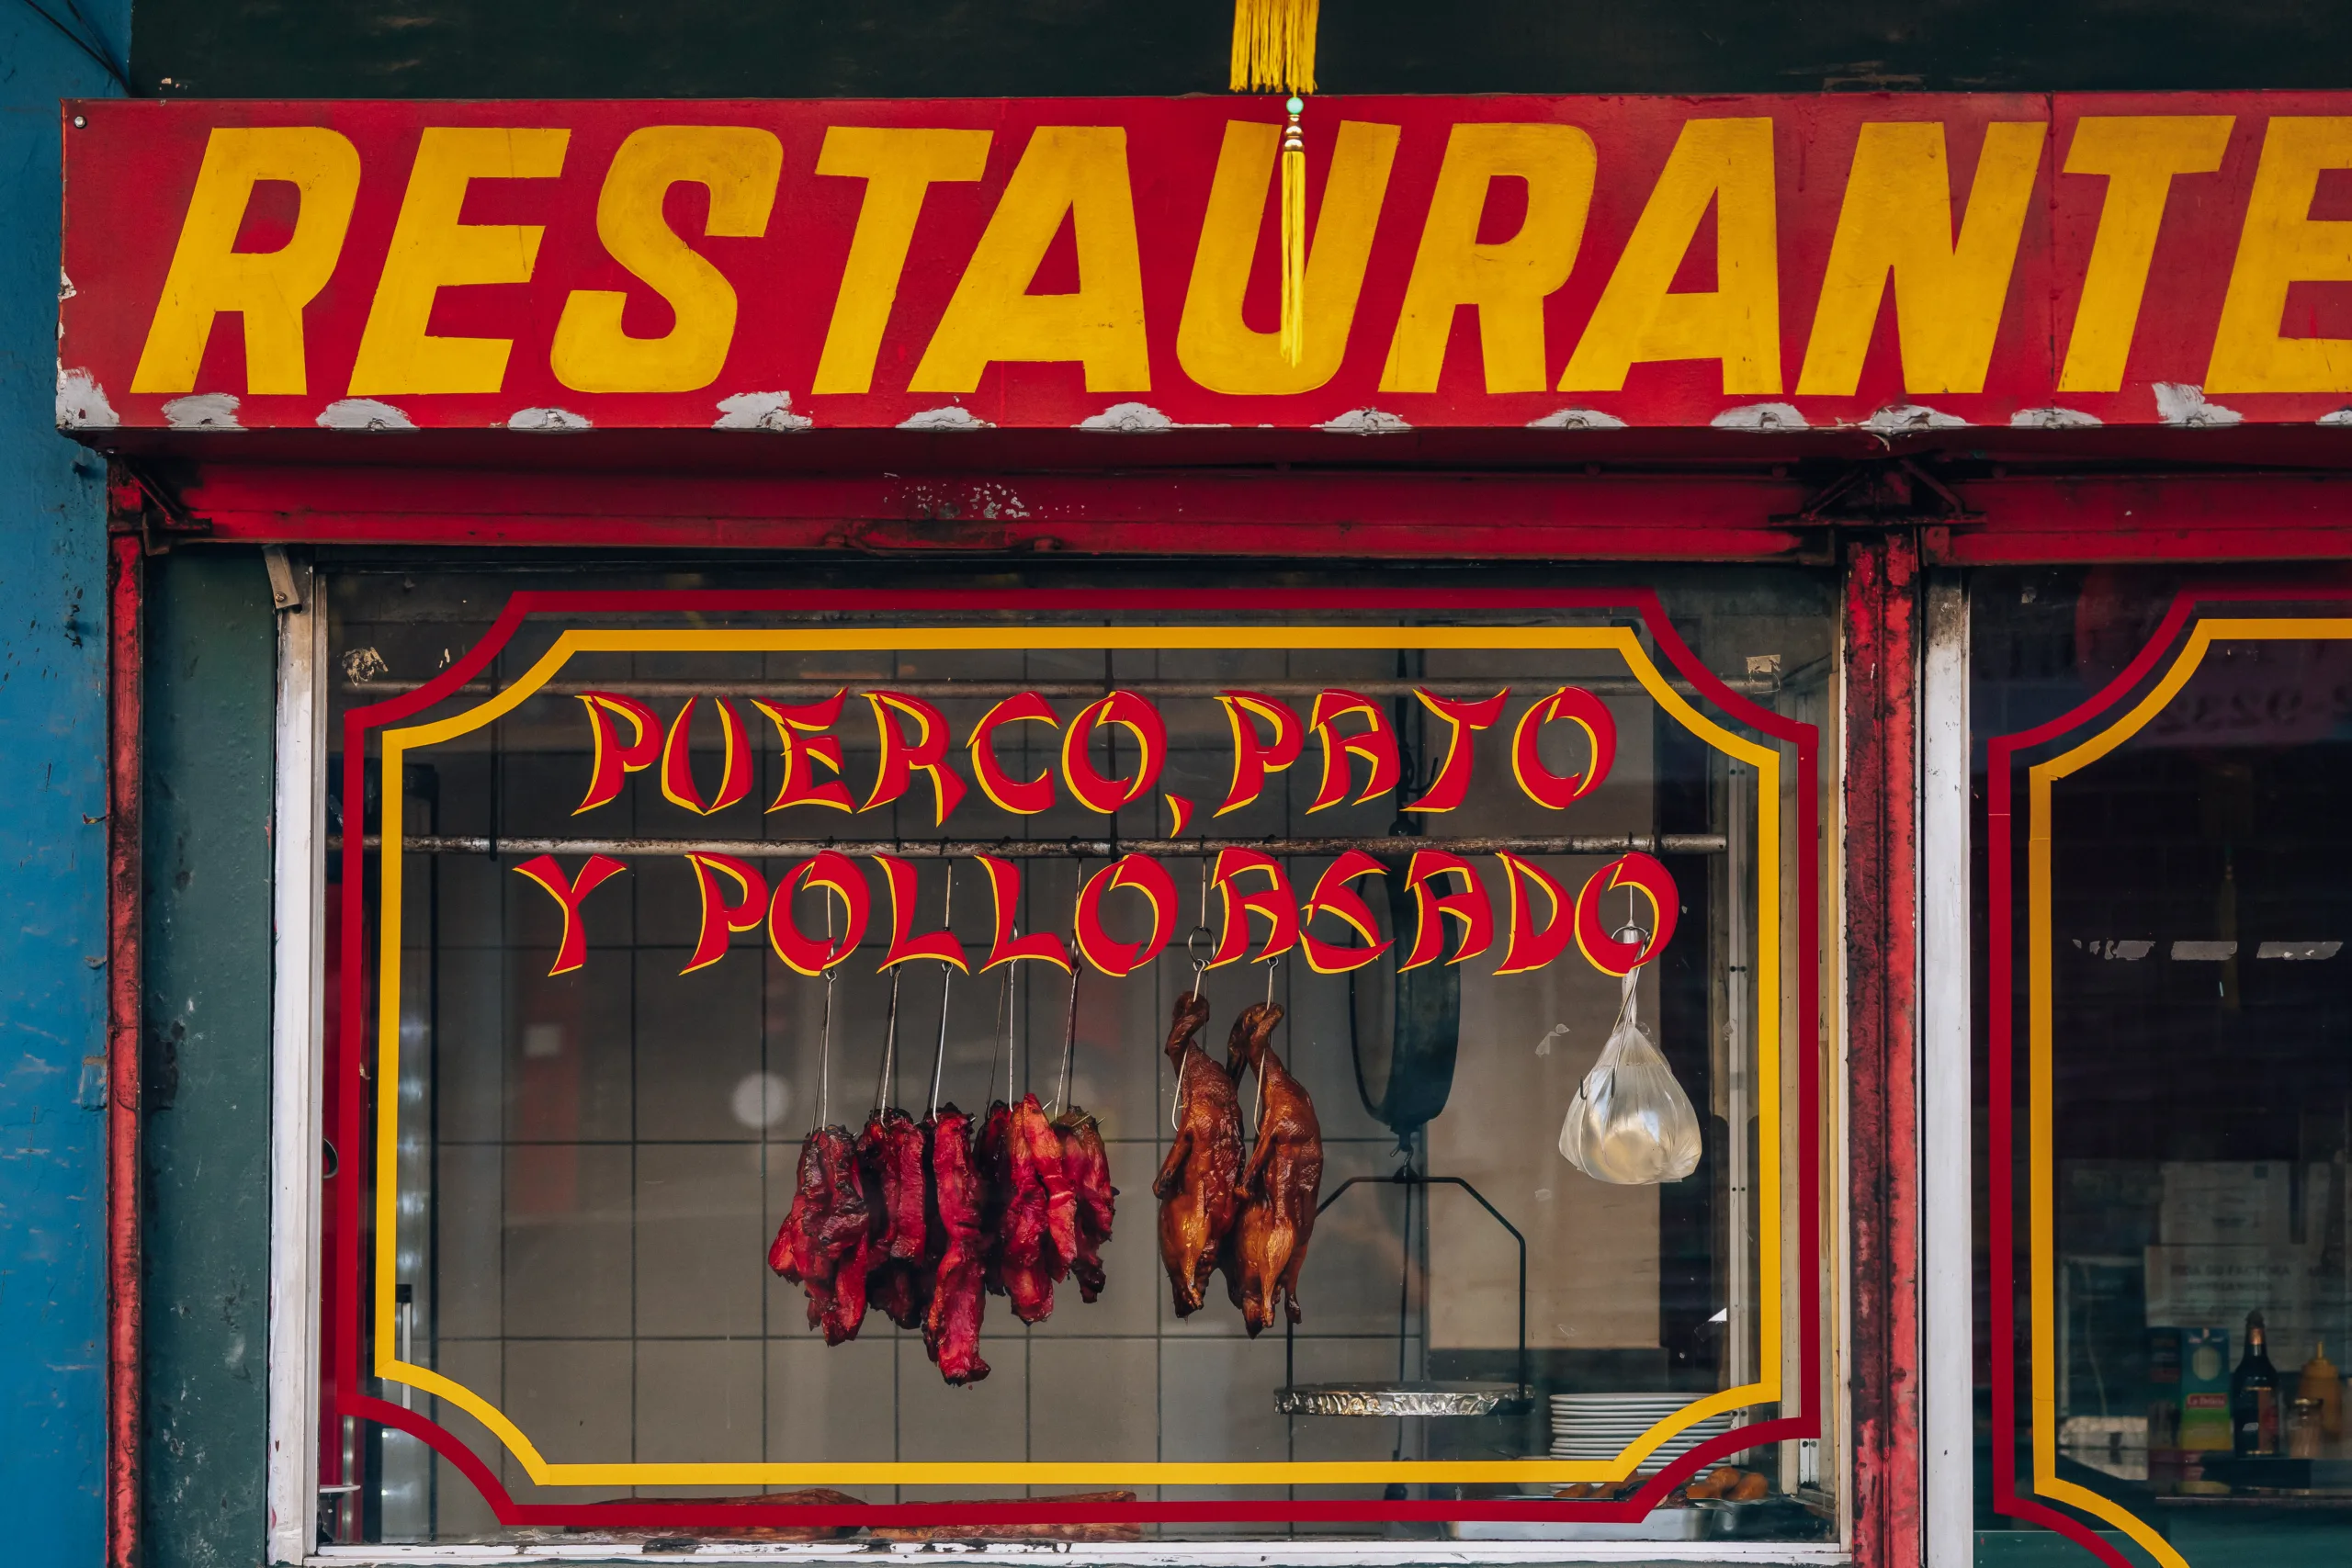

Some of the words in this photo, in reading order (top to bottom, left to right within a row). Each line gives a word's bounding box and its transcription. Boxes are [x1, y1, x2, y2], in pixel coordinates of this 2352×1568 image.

[130, 116, 2352, 396] RESTAURANTE
[571, 686, 1193, 839] PUERCO,
[1212, 685, 1617, 816] PATO
[513, 852, 628, 976] Y
[678, 850, 1180, 977] POLLO
[1204, 846, 1679, 977] ASADO
